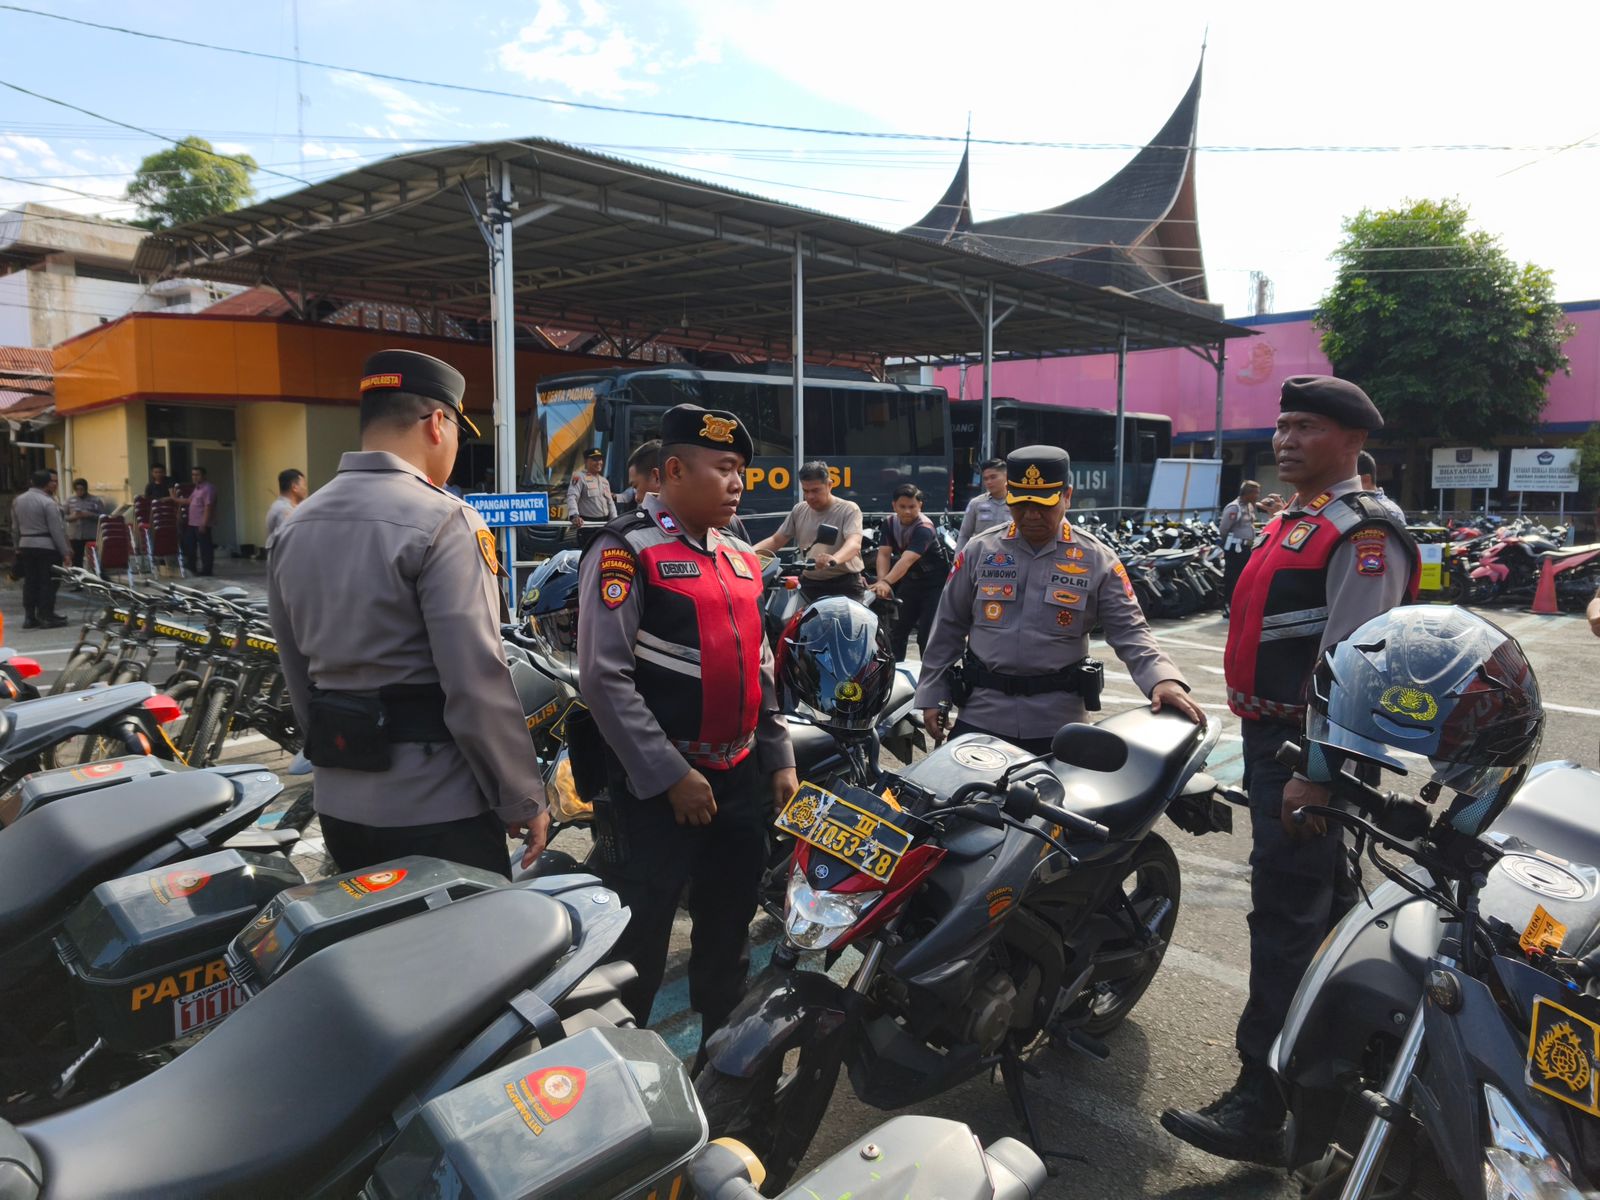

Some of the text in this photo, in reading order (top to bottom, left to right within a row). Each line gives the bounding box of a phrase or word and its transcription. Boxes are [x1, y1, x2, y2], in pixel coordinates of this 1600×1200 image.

[540, 390, 567, 404] OLRESTA
[745, 467, 851, 490] POSI
[1070, 470, 1107, 489] LISI
[470, 498, 544, 510] LAPANGAN PRAKTEK
[481, 511, 505, 523] UJI
[509, 510, 536, 522] SIM
[1051, 574, 1089, 588] POLRI
[172, 628, 209, 644] POLIS
[527, 702, 558, 730] OLISI
[855, 814, 878, 837] III
[131, 959, 231, 1012] PATR
[192, 980, 228, 1000] LAYANAN
